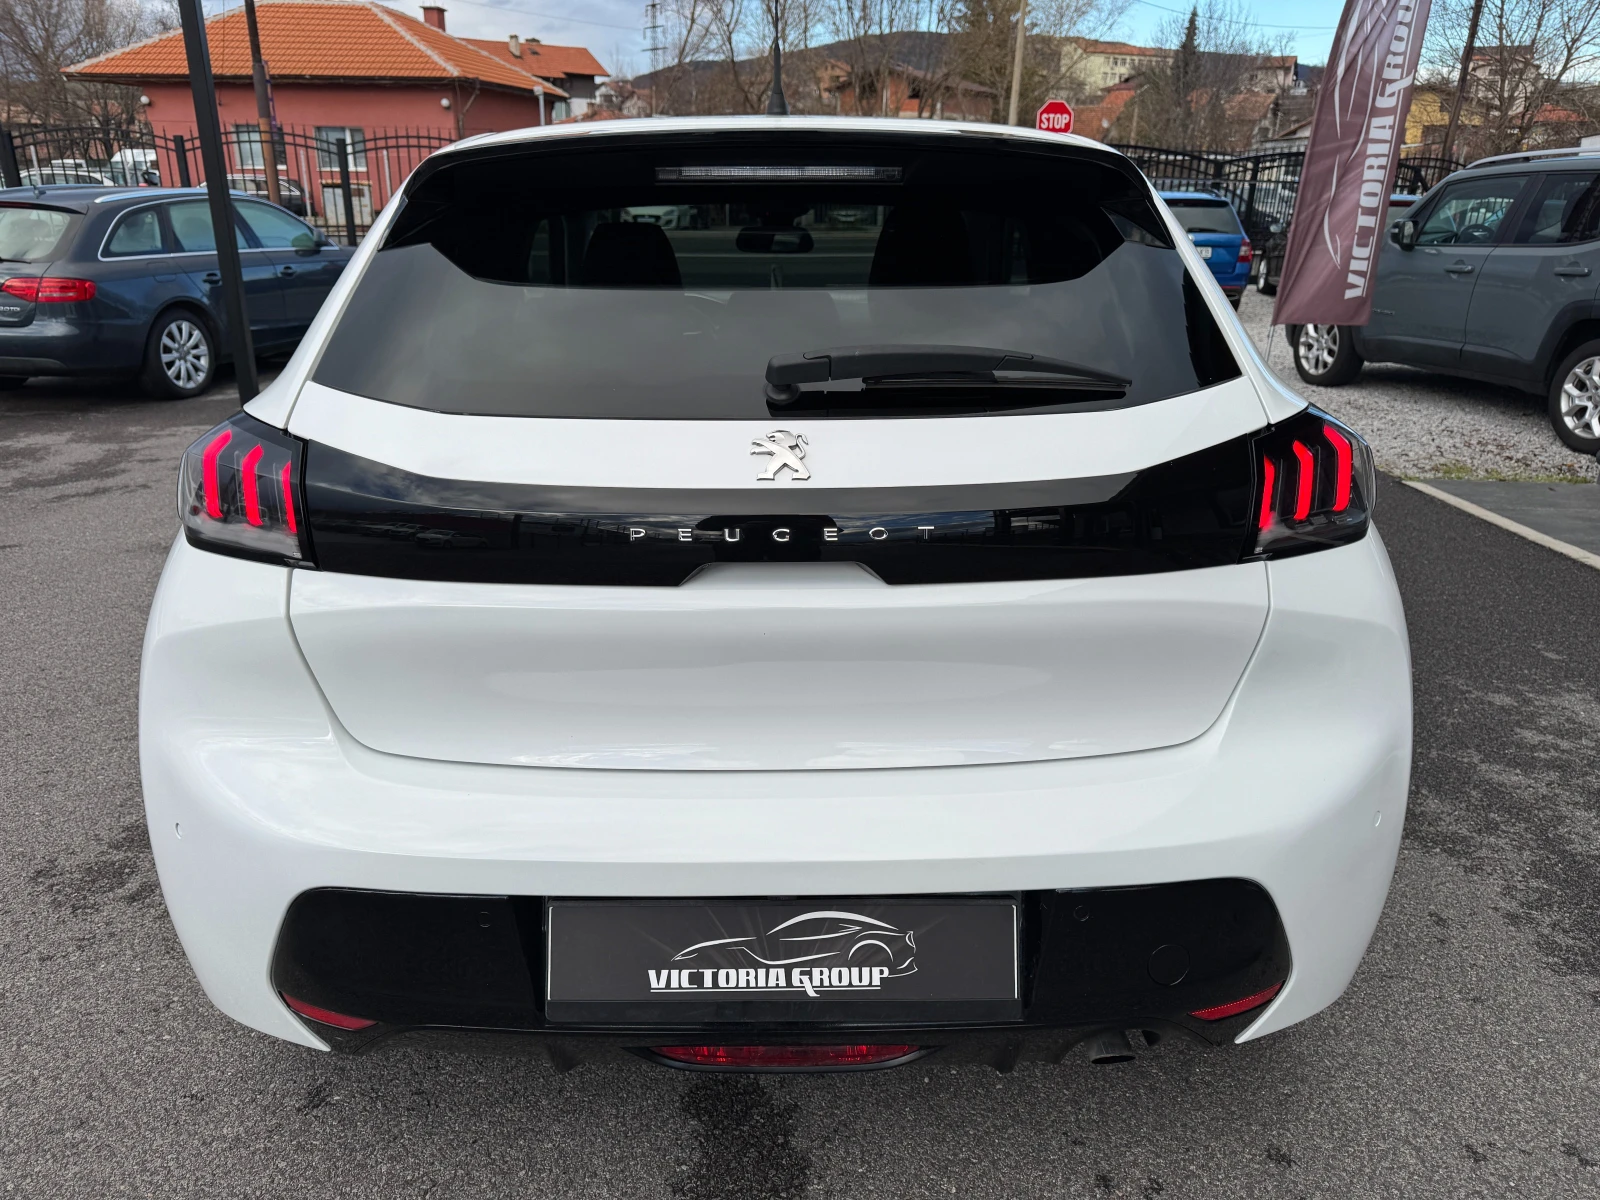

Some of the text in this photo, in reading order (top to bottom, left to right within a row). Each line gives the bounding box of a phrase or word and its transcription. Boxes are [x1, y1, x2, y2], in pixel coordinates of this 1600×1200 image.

[1040, 113, 1070, 129] STOP
[1344, 114, 1395, 300] VICTORIA
[629, 525, 935, 542] PEUGEOT
[648, 965, 890, 997] VICTORIA GROUP
